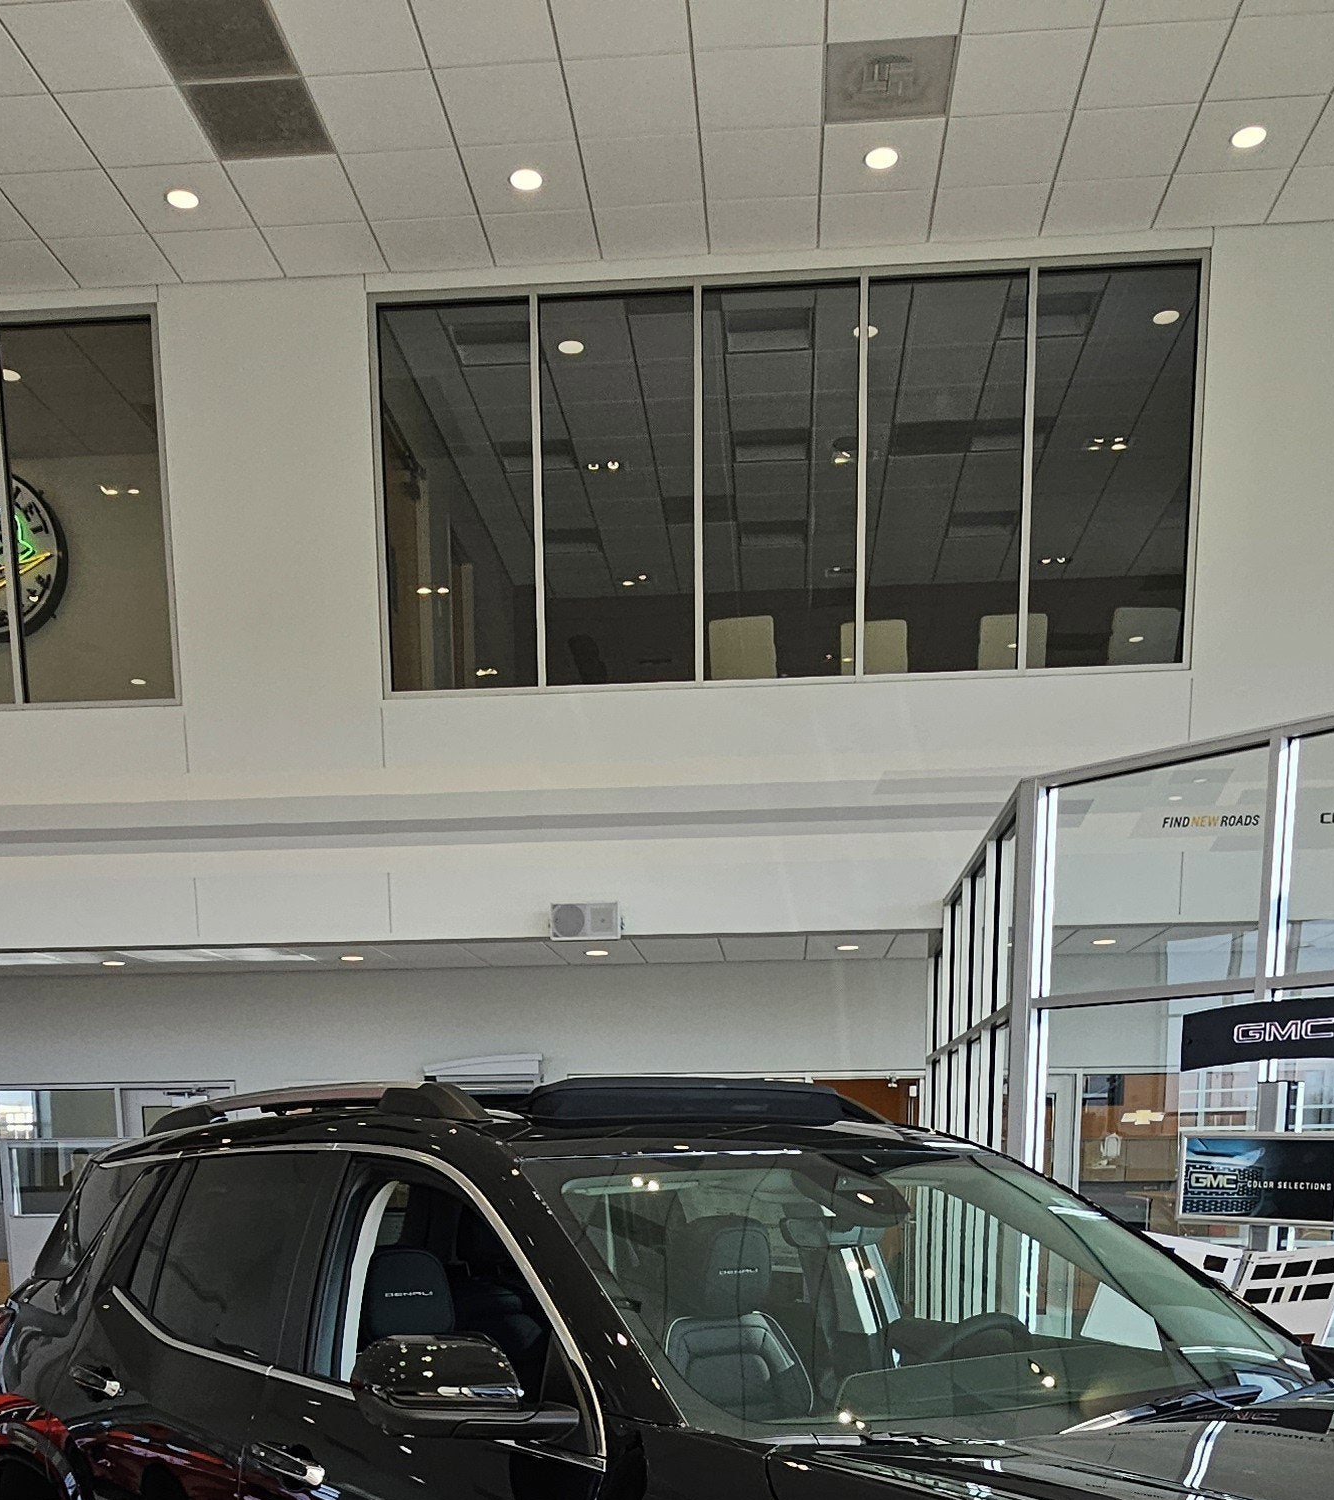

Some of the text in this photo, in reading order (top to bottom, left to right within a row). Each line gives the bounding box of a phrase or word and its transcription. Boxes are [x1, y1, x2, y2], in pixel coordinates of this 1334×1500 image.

[1161, 813, 1261, 829] FIND NEW ROADS
[1190, 1172, 1237, 1189] GMC
[1246, 1180, 1332, 1191] COLOR SELECTIONS
[384, 1290, 434, 1298] DENALI
